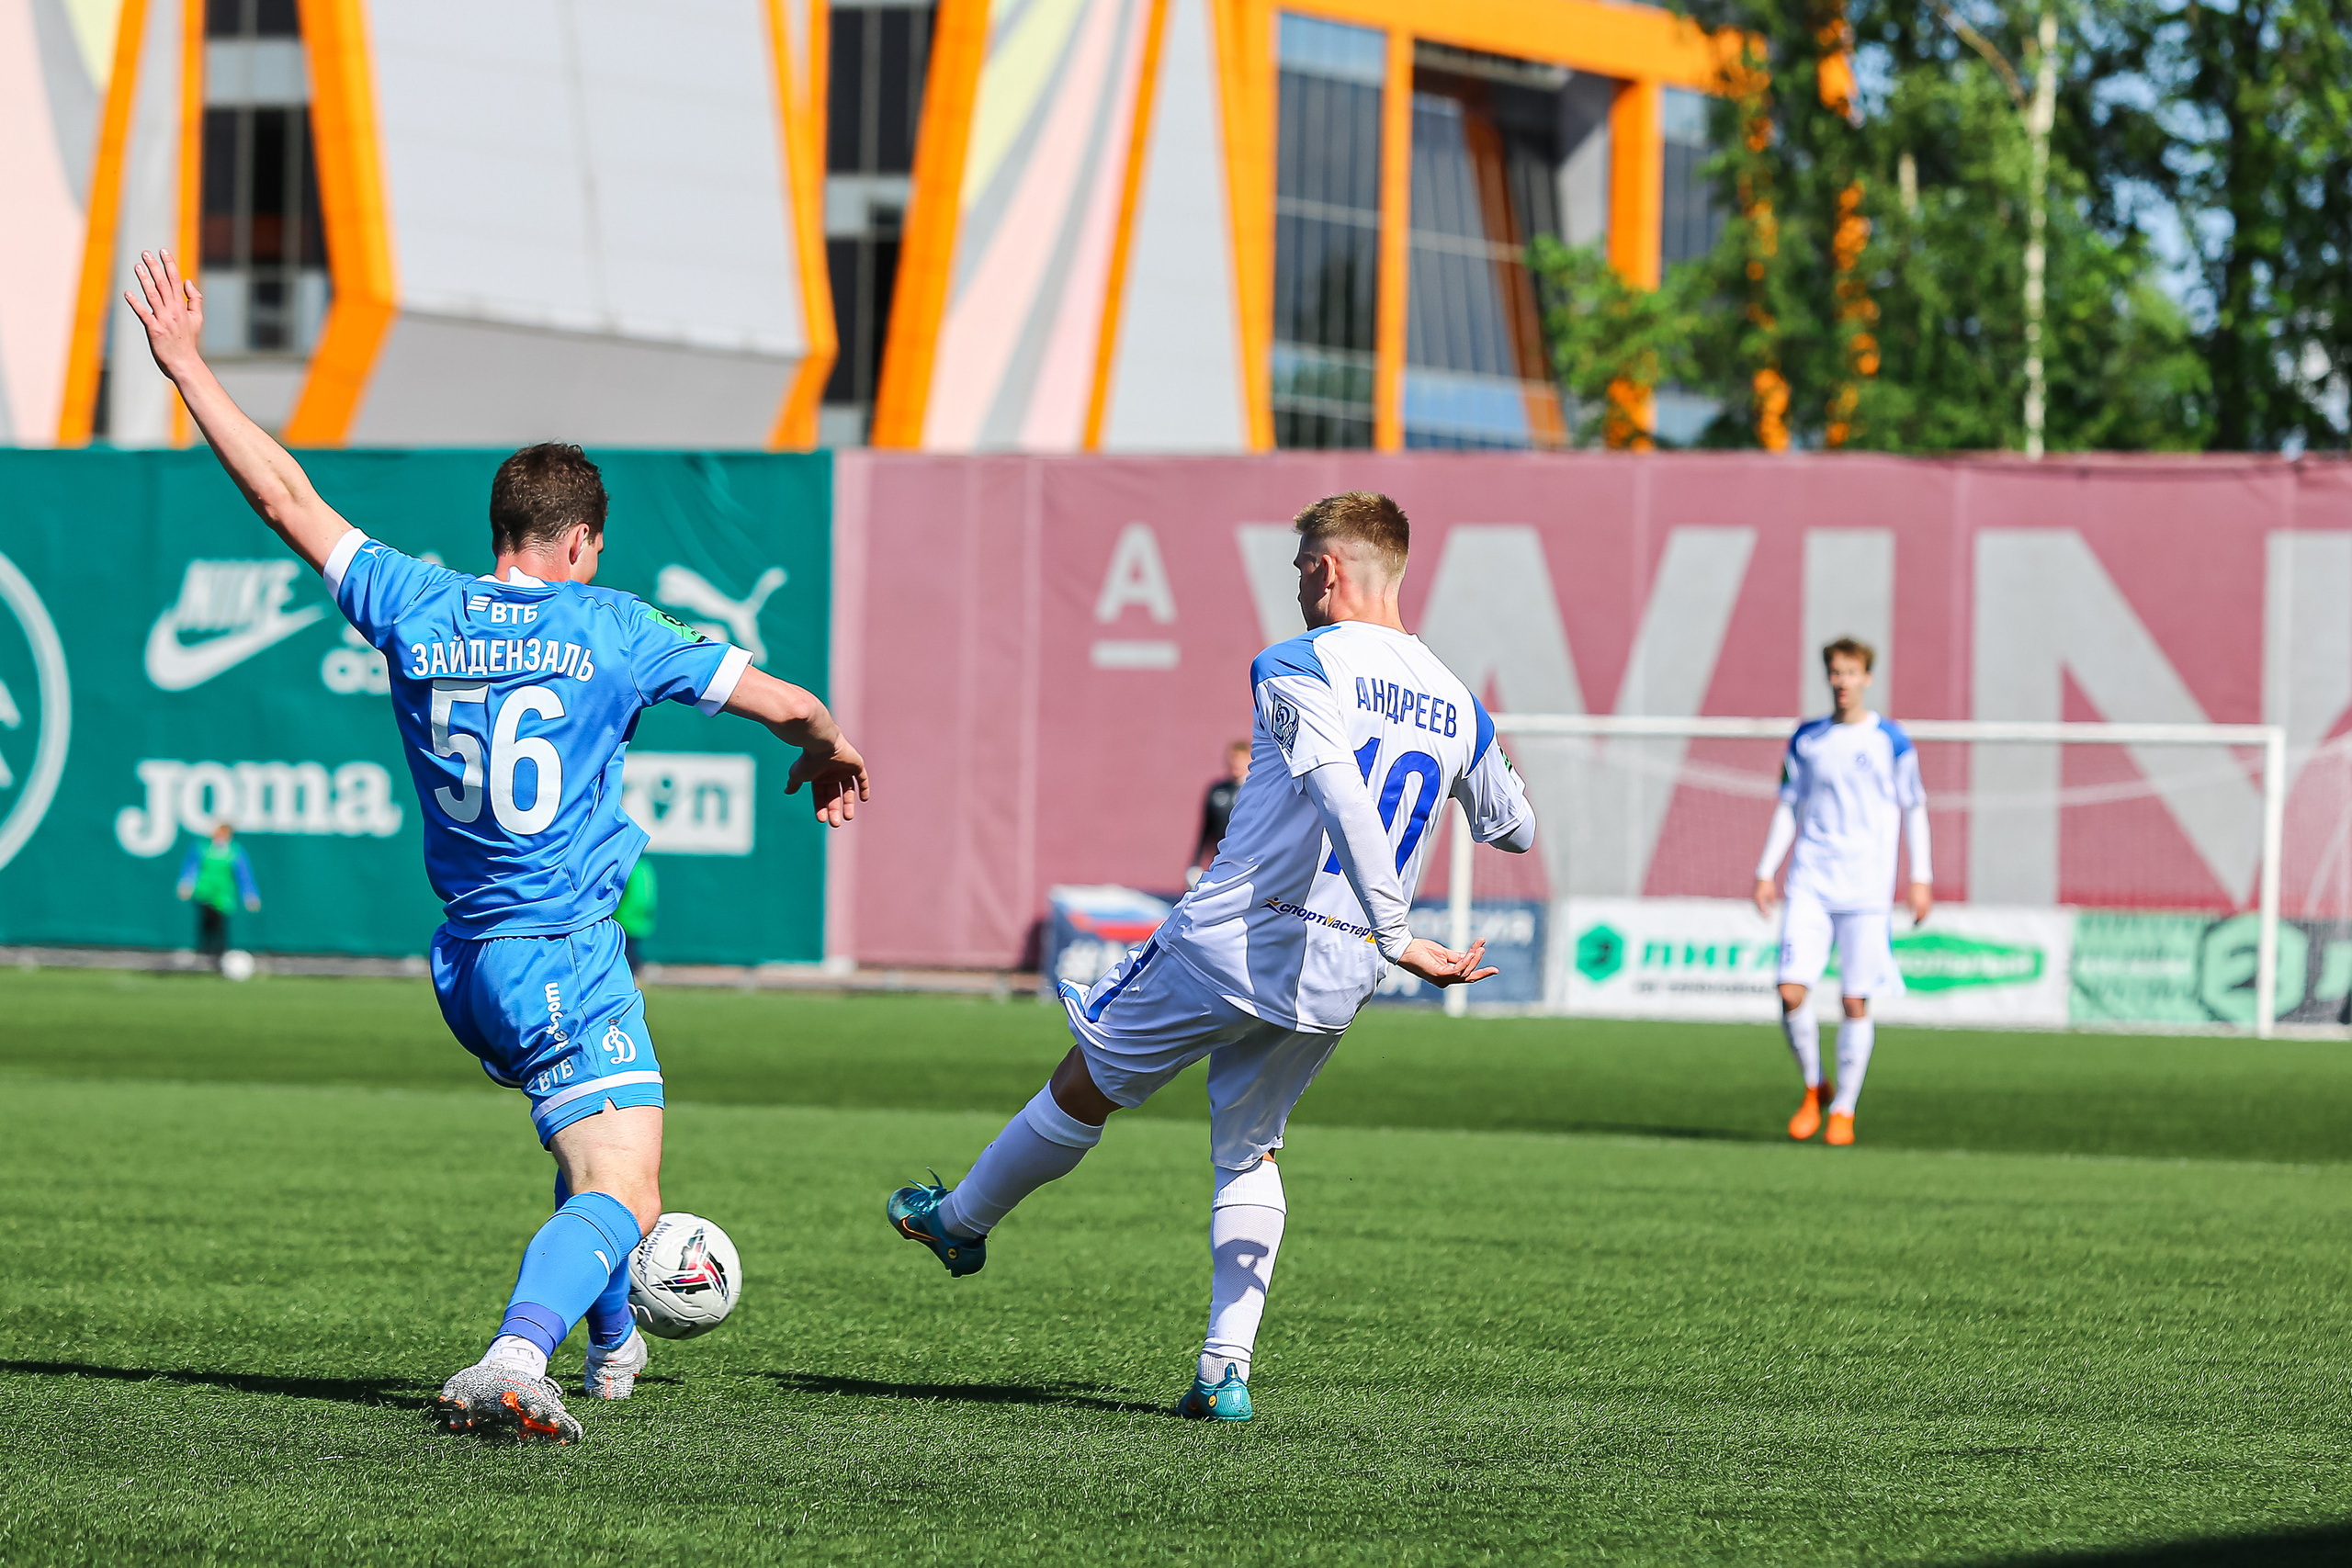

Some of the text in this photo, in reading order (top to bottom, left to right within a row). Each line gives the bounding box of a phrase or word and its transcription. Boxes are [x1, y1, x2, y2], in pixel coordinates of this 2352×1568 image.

[490, 601, 539, 625] ВТБ
[410, 634, 595, 682] ЗАЙДЕНЗАЛЬ
[1355, 676, 1458, 739] АНДРЕЕВ
[430, 680, 566, 836] 56
[537, 1056, 575, 1093] ВТБ
